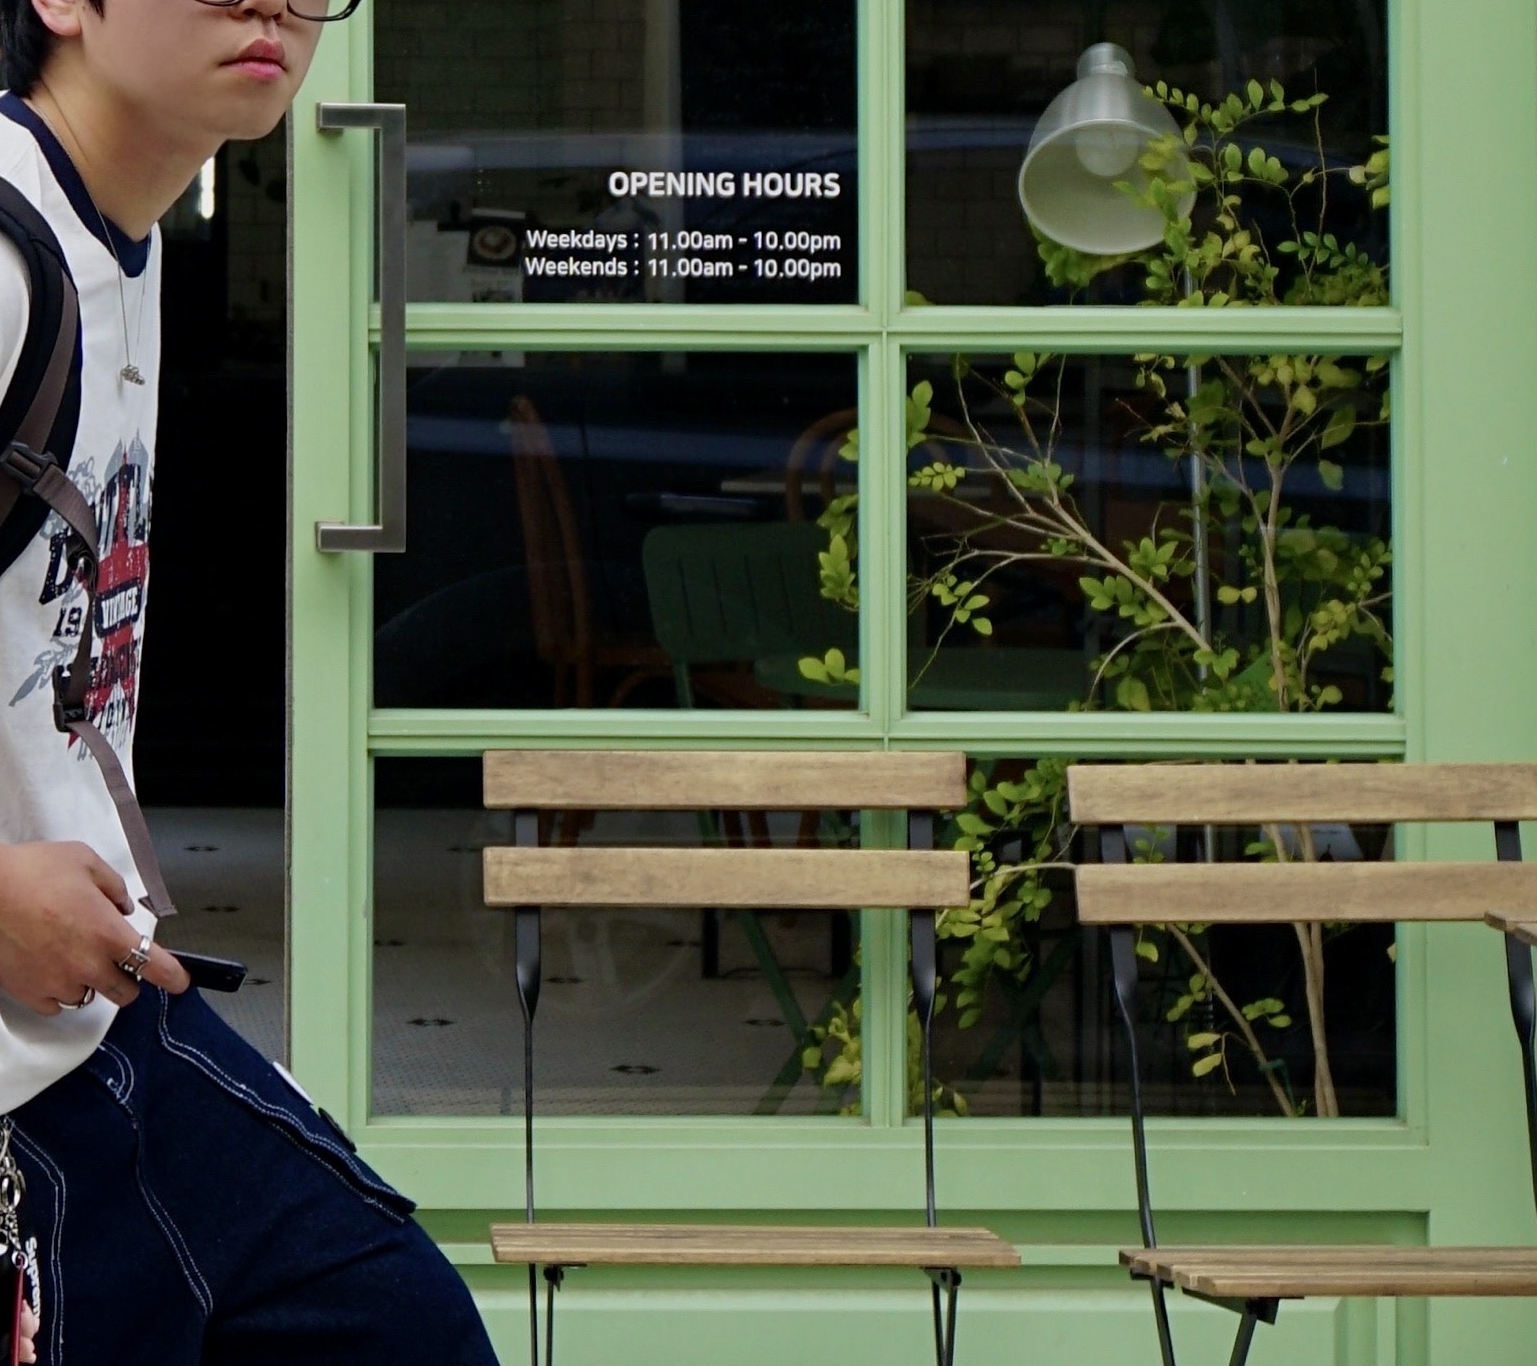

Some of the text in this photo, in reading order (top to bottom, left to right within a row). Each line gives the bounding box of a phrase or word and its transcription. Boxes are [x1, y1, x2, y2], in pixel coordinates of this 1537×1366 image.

[609, 171, 841, 198] OPENING HOURS
[526, 229, 628, 253] Weekdays
[648, 230, 734, 251] 11.00am
[753, 230, 841, 254] 10.00pm
[525, 256, 628, 276] Weekends
[648, 257, 734, 278] 11.00am
[753, 257, 841, 282] 10.00pm
